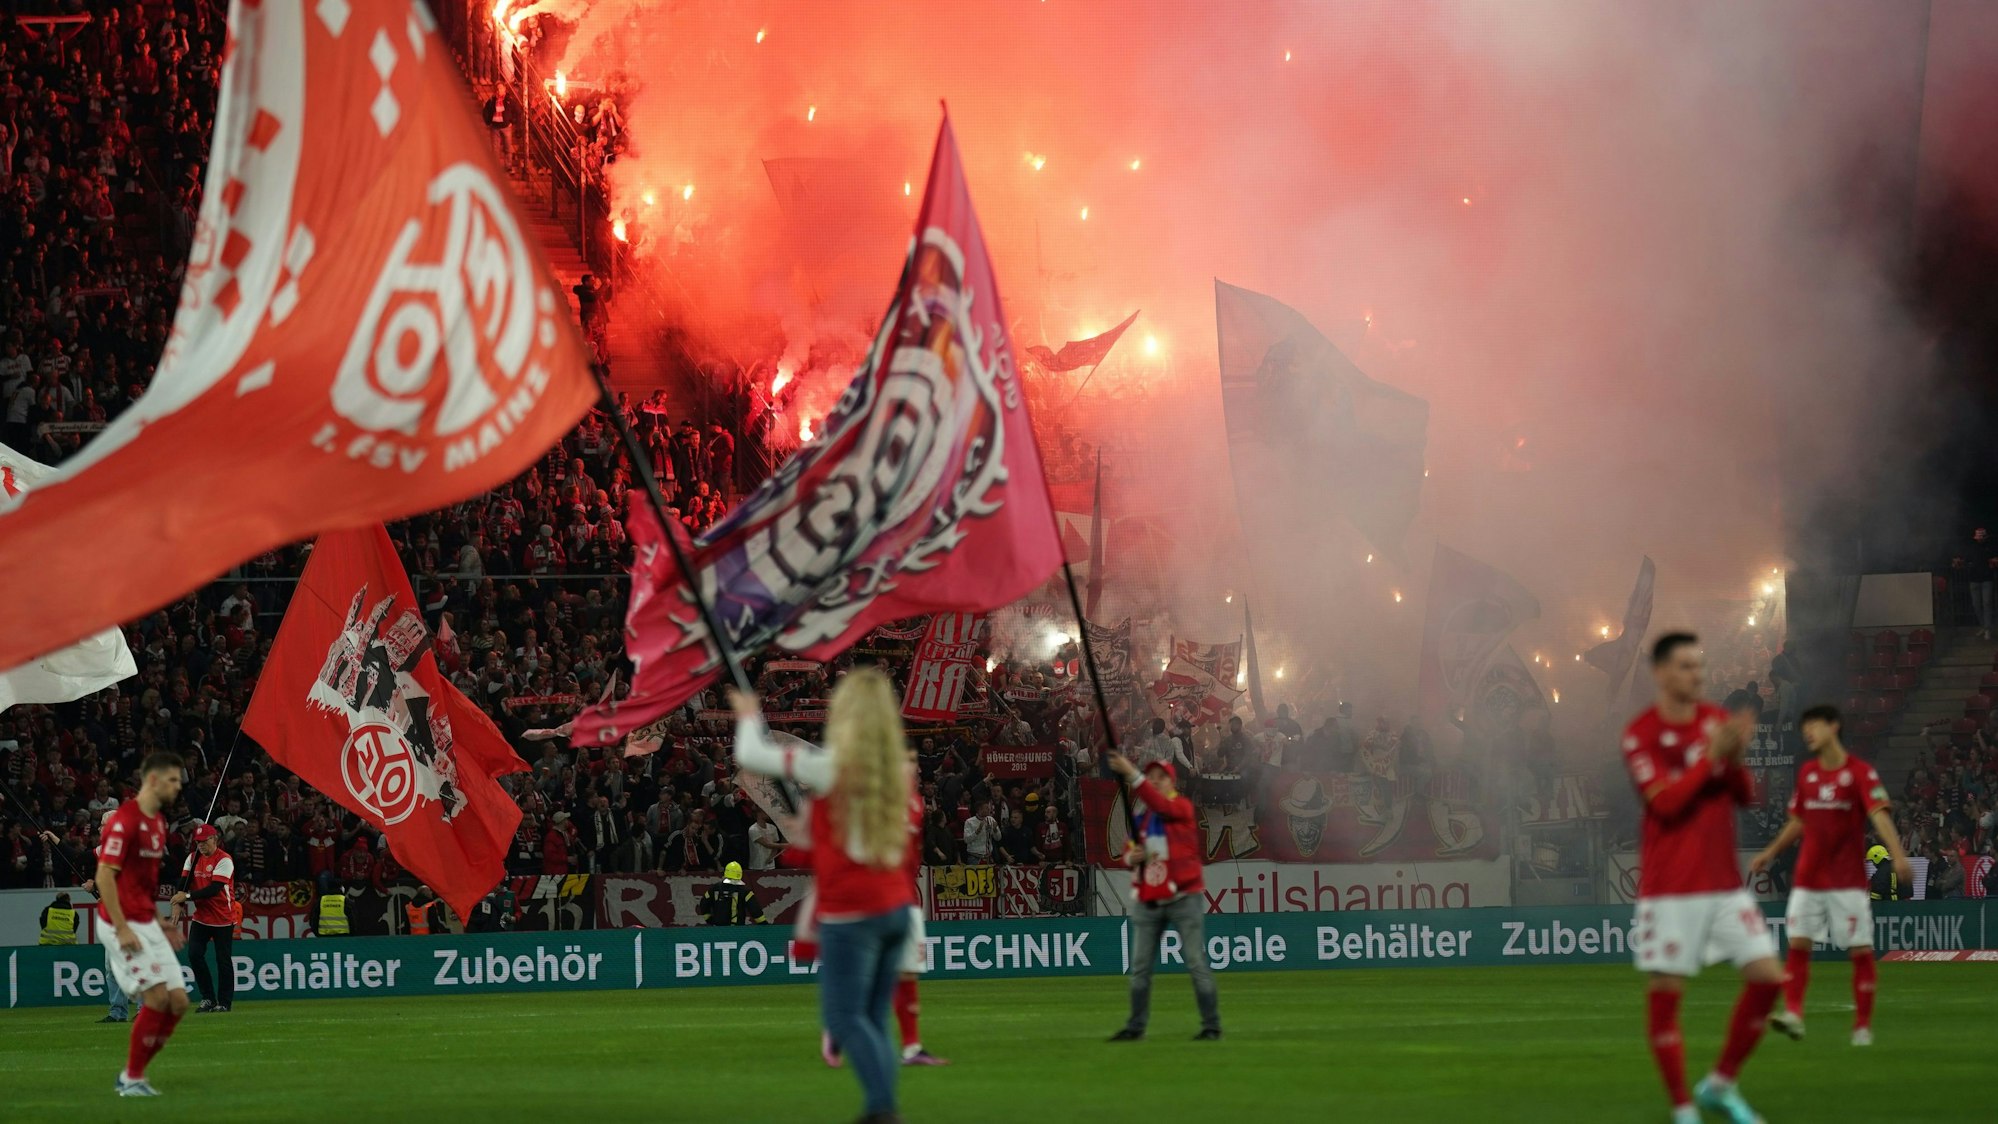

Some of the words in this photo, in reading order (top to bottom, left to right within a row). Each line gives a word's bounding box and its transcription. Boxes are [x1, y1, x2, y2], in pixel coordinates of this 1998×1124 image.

[346, 434, 427, 474] FSV
[986, 750, 1015, 763] HÖHER
[1024, 751, 1053, 763] JUNGS
[1011, 762, 1028, 772] 2013
[251, 885, 287, 905] 2012
[1160, 926, 1287, 970] Rgale
[1317, 922, 1472, 961] Behälter
[1502, 919, 1643, 956] Zubehö
[231, 951, 401, 992] Behälter
[434, 945, 603, 986] Zubehör
